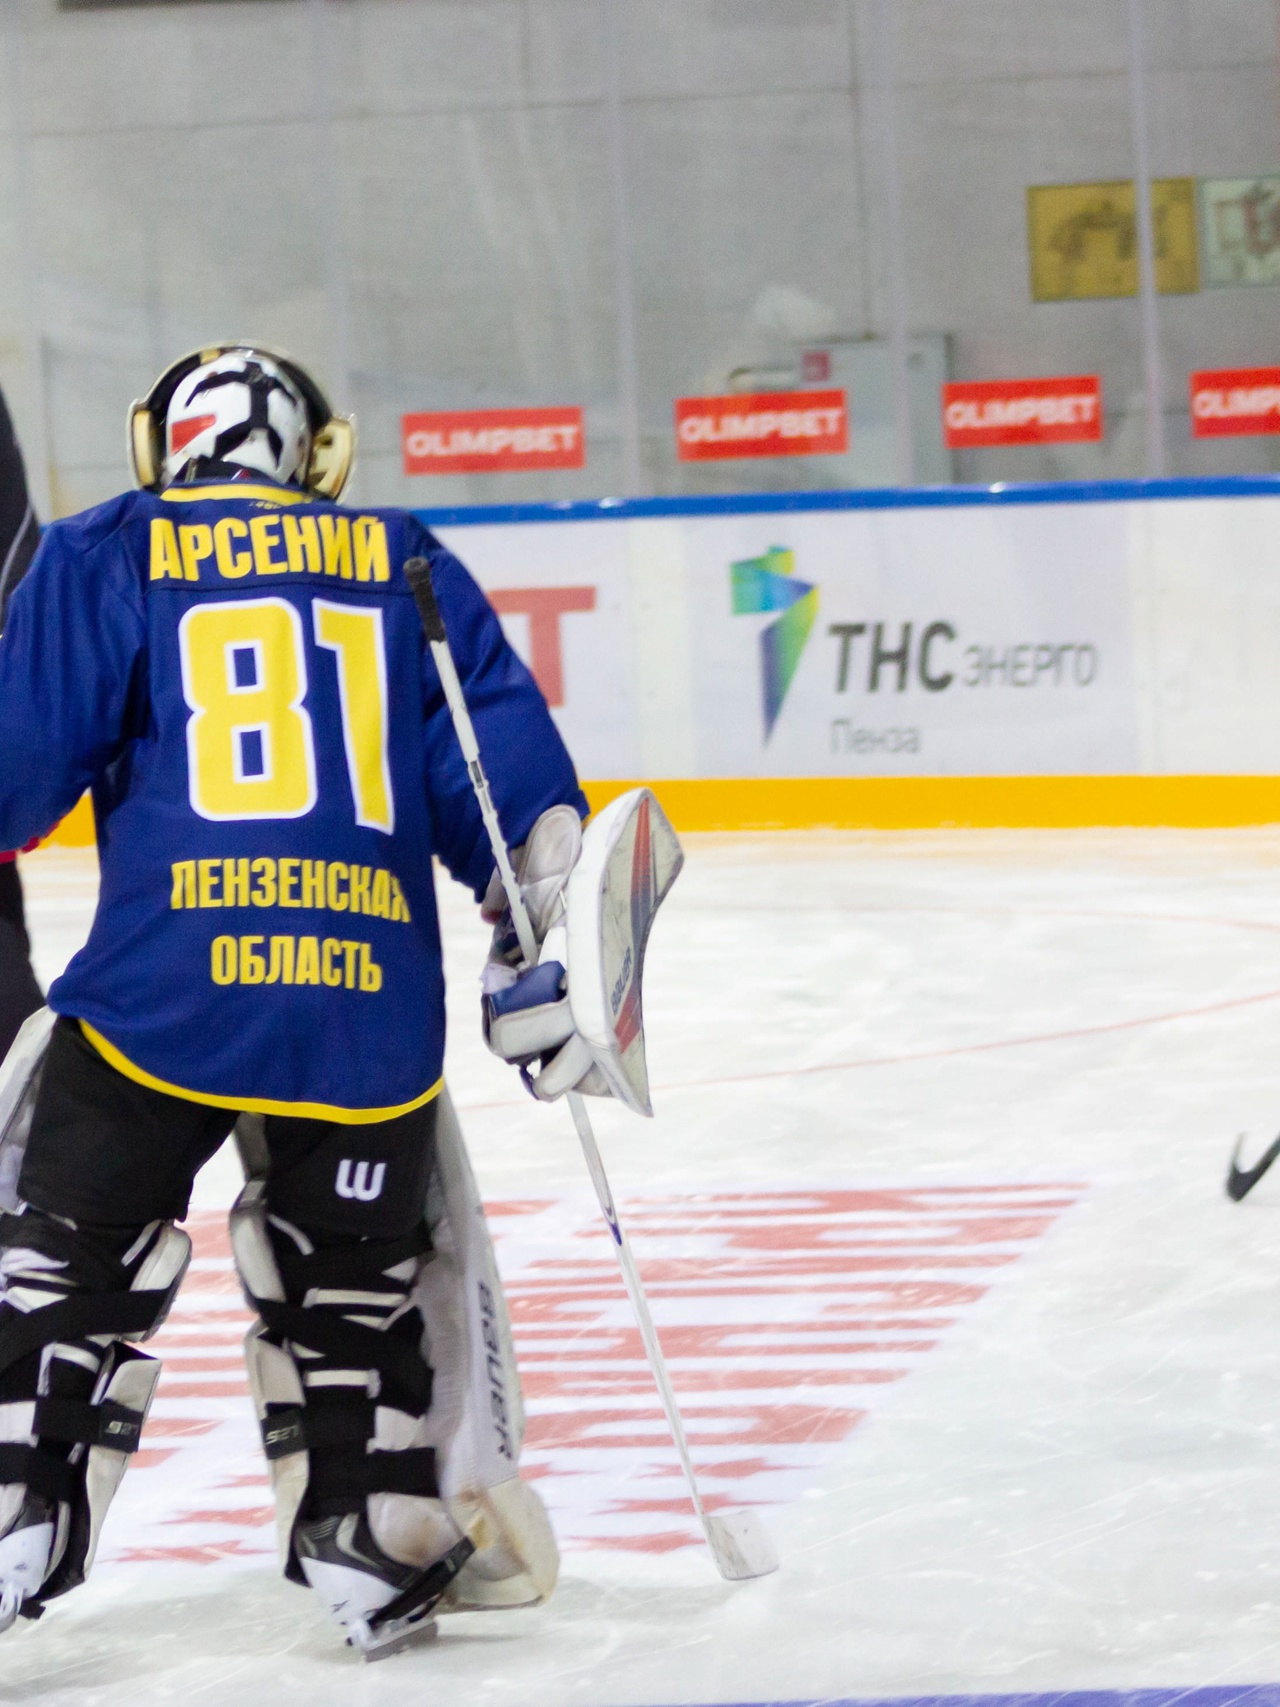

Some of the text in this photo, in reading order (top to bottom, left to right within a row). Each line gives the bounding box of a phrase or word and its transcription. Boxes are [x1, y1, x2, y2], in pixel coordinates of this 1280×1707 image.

[678, 407, 843, 443] OLIMPBET
[945, 394, 1098, 430] OLIMPBET
[1192, 385, 1280, 419] OLIMP
[405, 424, 579, 458] OLIMPBET
[149, 514, 391, 582] АРСЕНИЙ
[827, 620, 1099, 693] ТНС ЭНЕРГО
[178, 596, 395, 836] 81
[829, 716, 921, 755] Пенза
[170, 856, 412, 924] ПЕНЗЕНСКАЯ
[210, 934, 383, 993] ОБЛАСТЬ
